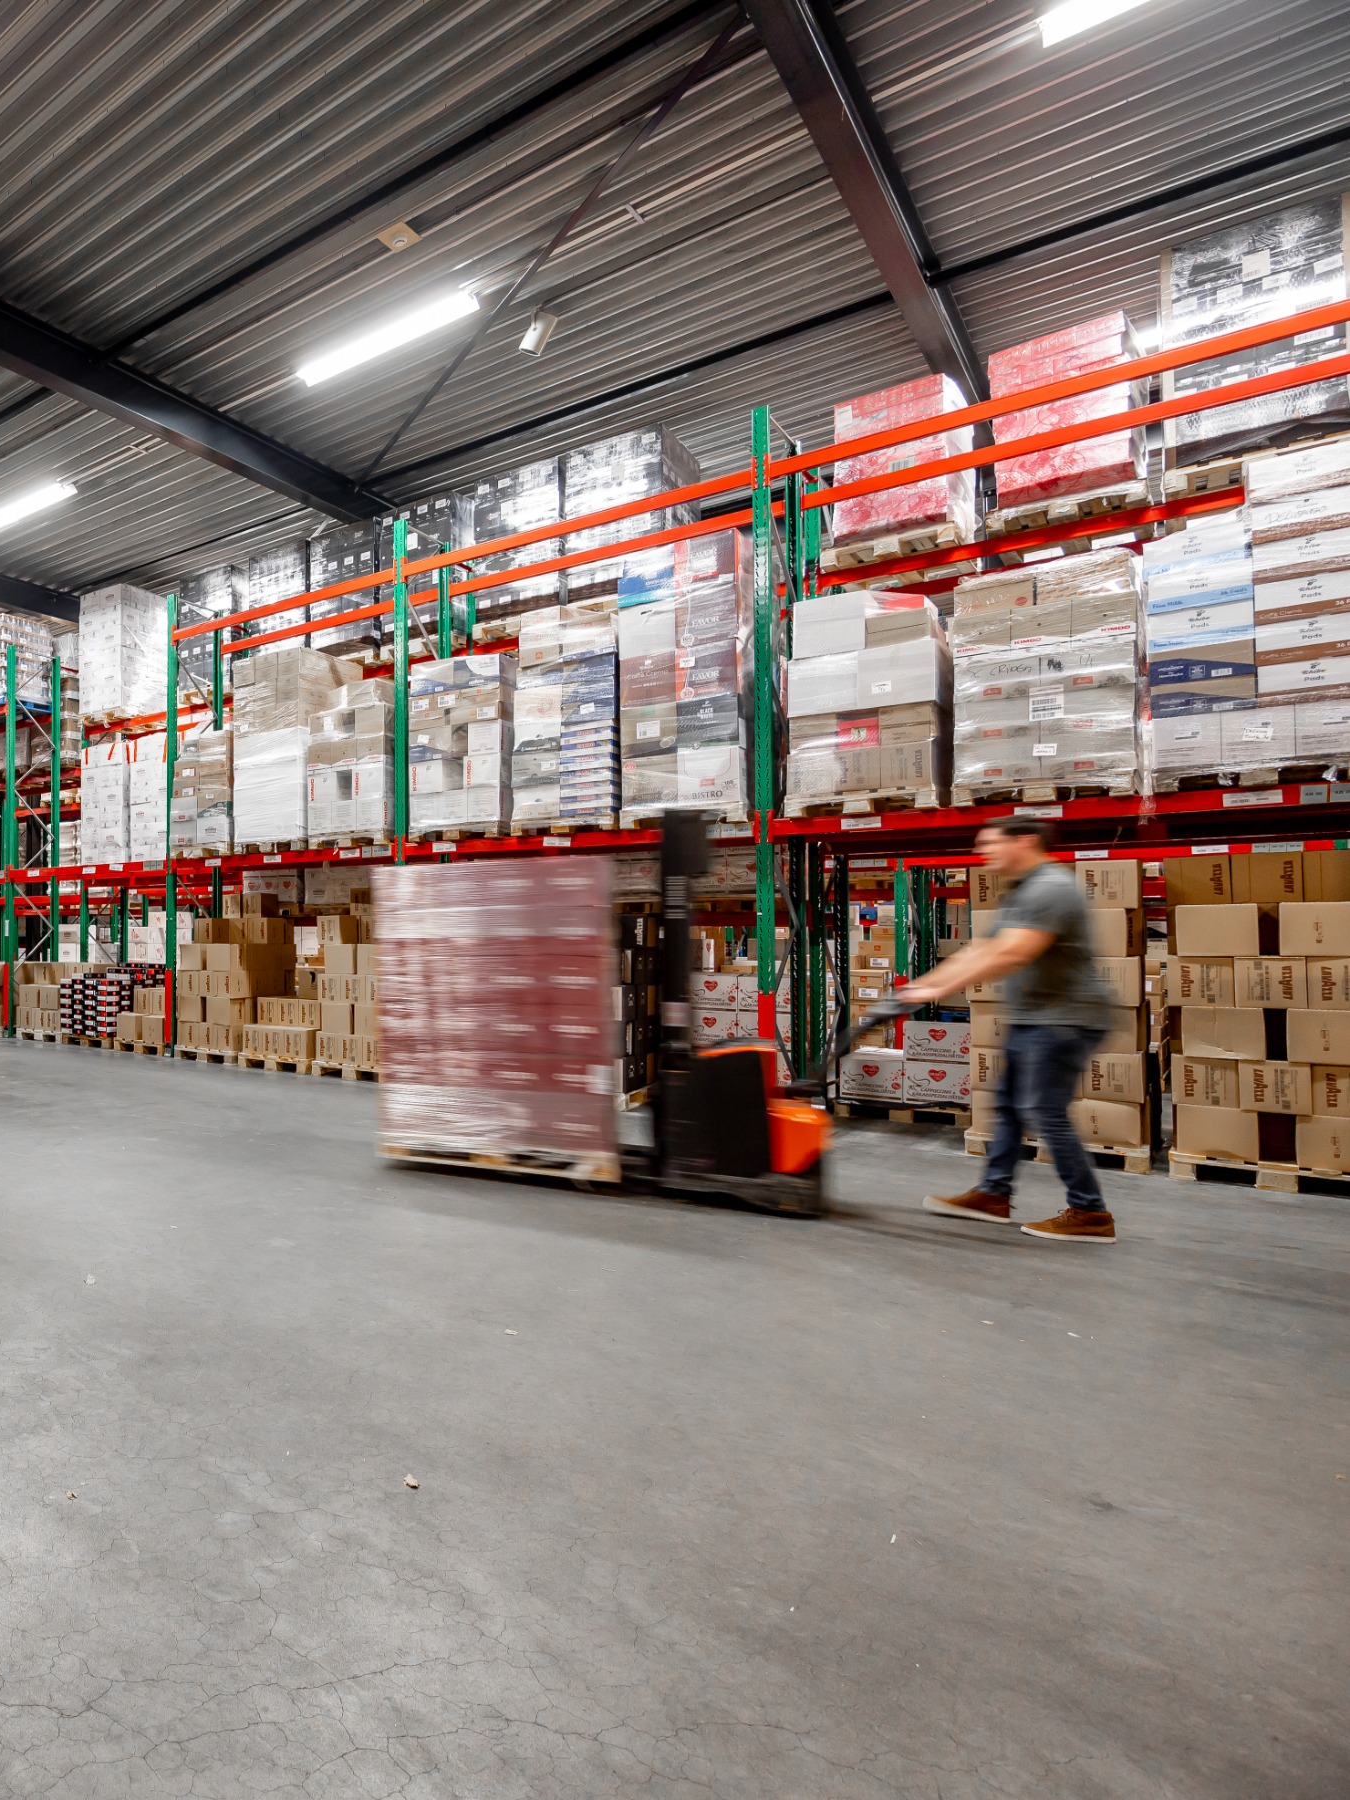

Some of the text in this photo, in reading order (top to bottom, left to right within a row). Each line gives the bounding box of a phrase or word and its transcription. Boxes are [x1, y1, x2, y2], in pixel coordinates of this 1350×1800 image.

[691, 616, 719, 627] FAVOR
[1100, 624, 1130, 632] KIMBO
[1014, 637, 1042, 645] KIMBO
[692, 670, 720, 681] FAVOR
[692, 790, 723, 799] BISTRO
[978, 874, 990, 902] LAVAZZA
[1210, 863, 1224, 896] LAVAZZA
[1280, 860, 1295, 894] LAVAZZA
[636, 917, 644, 946] LAVAZZA
[1180, 965, 1194, 998] LAVAZZA
[1278, 965, 1294, 1000] LAVAZZA
[1321, 966, 1336, 1001] LAVAZZA
[978, 1053, 989, 1083] LAVAZZA
[1092, 1060, 1104, 1091] LAVAZZA
[1184, 1064, 1198, 1097] LAVAZZA
[1253, 1068, 1268, 1103] LAVAZZA
[1326, 1073, 1341, 1108] LAVAZZA
